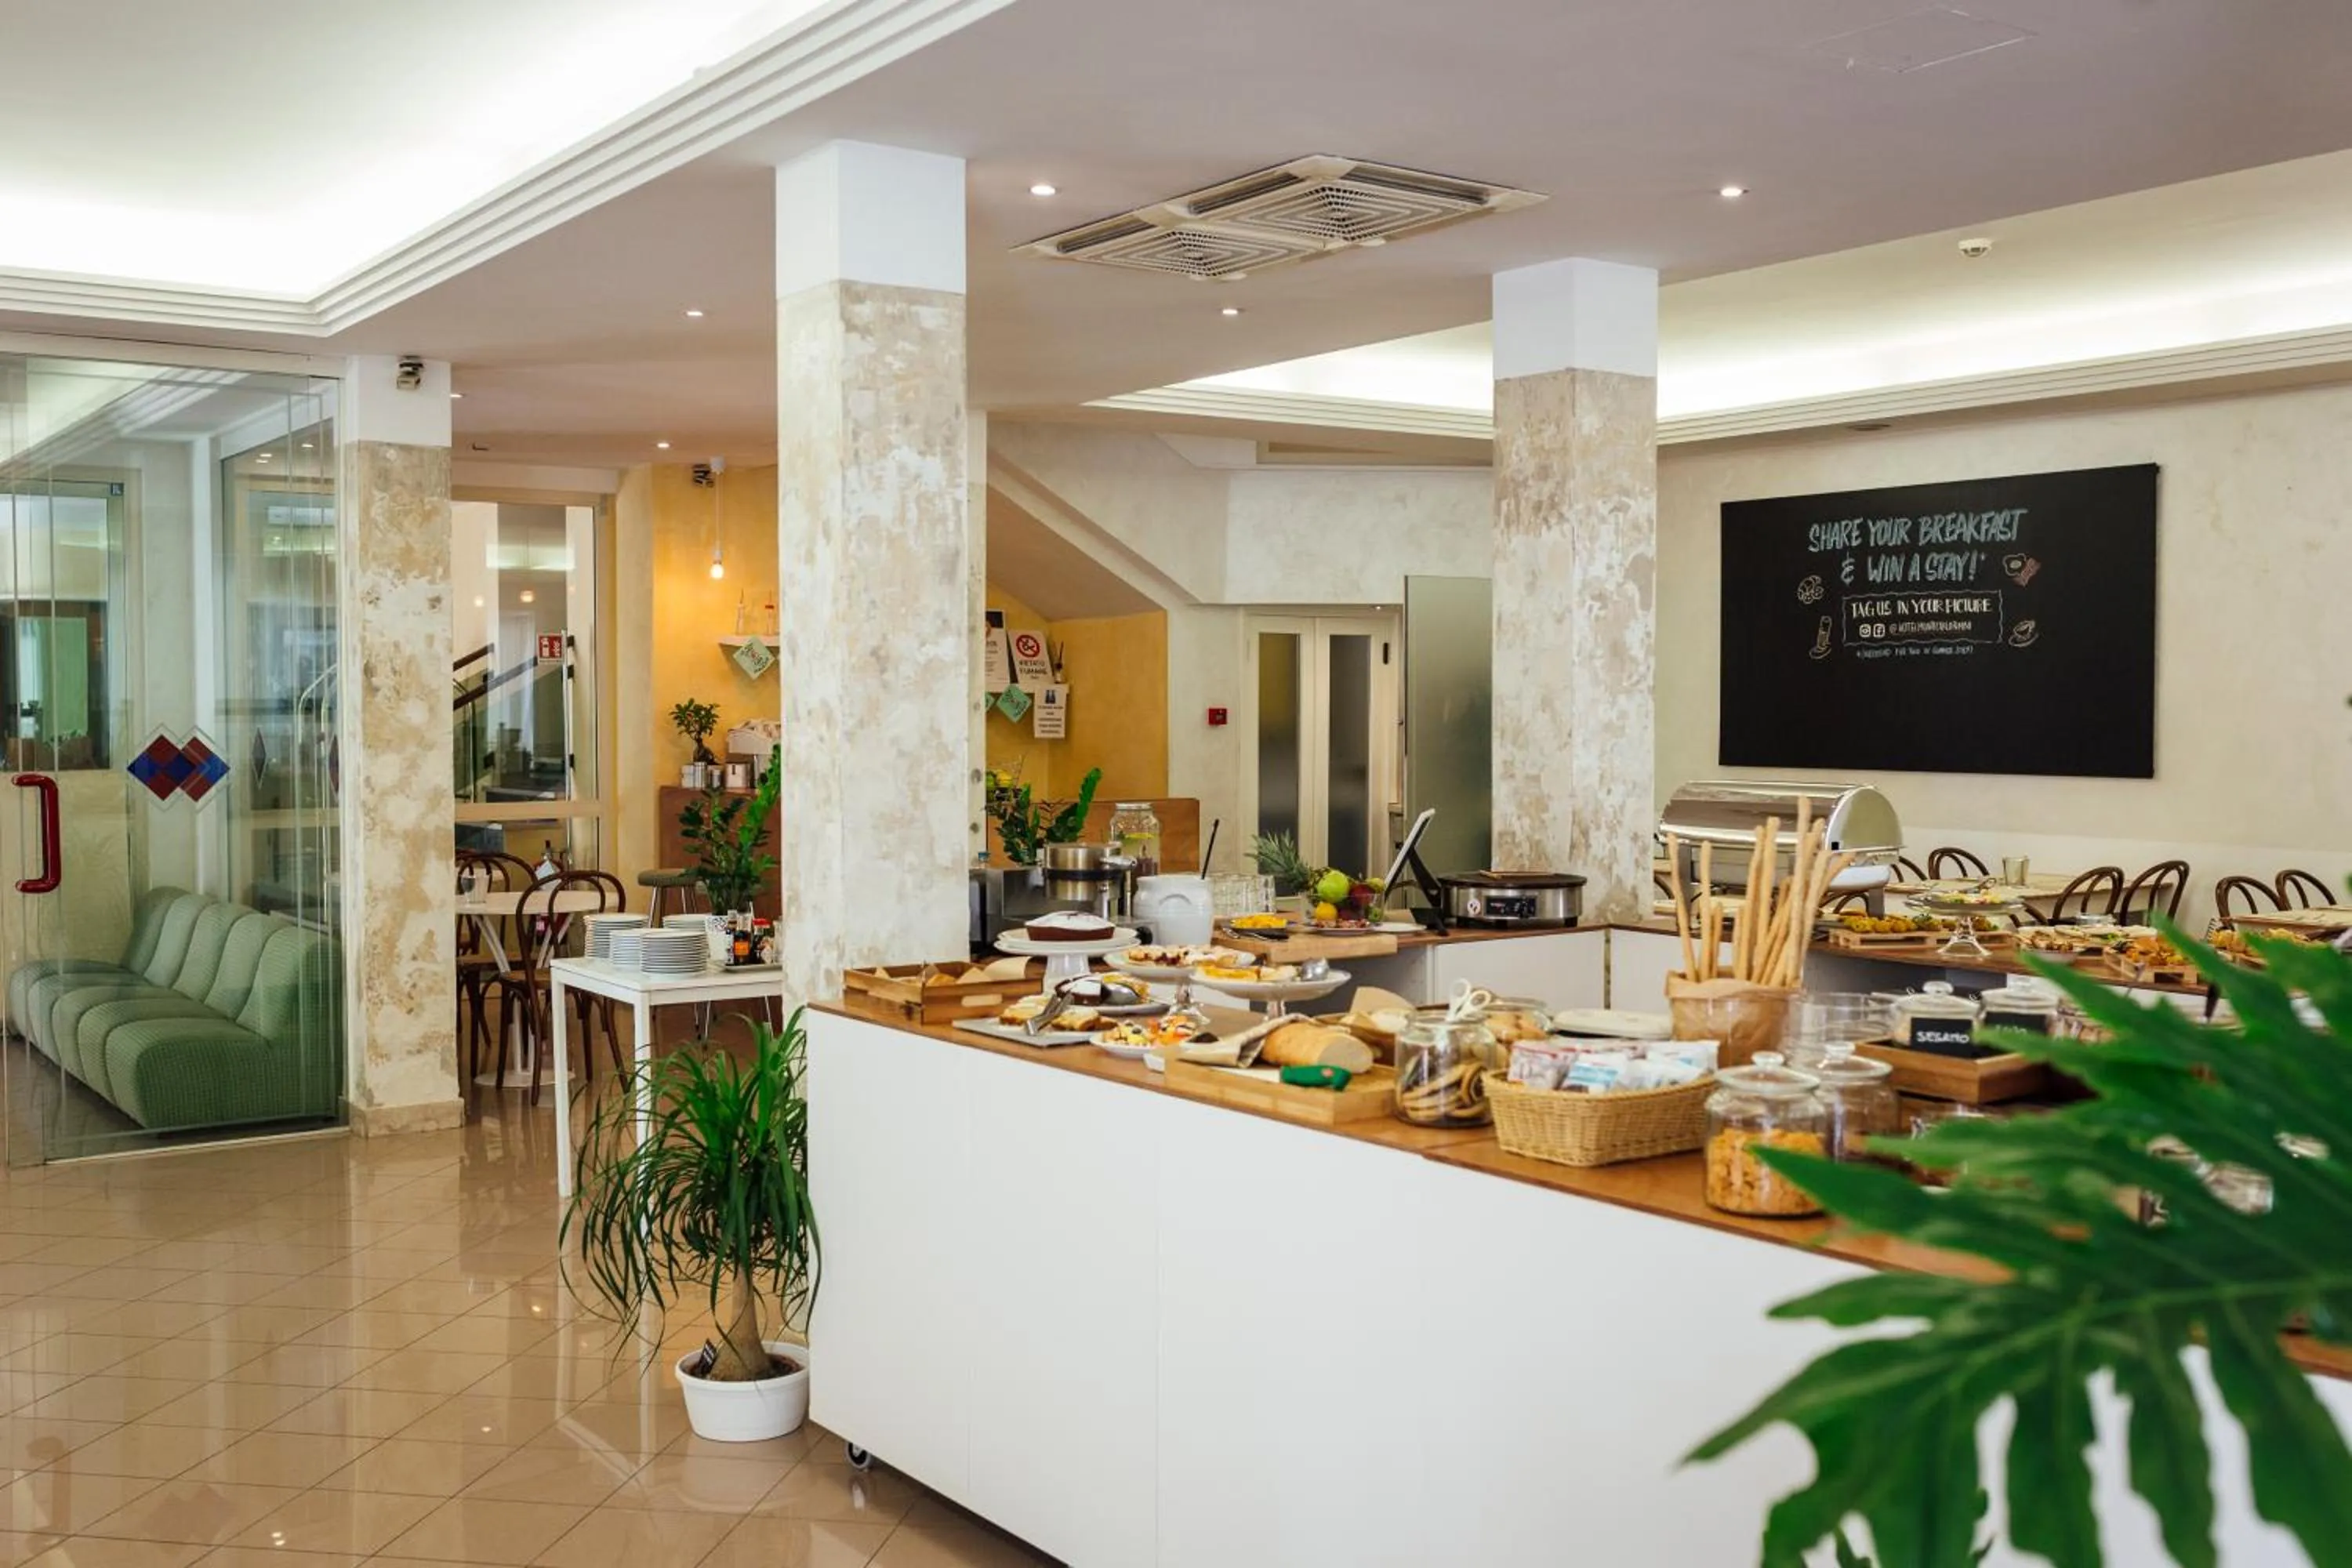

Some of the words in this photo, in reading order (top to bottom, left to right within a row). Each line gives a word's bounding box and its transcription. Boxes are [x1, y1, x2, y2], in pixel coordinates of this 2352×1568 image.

[1808, 517, 1864, 552] SHARE
[1868, 517, 1911, 546] YOUR
[1918, 509, 2028, 546] BREAKFAST
[1841, 551, 1855, 586] &
[1867, 553, 1905, 583] WIN
[1907, 554, 1921, 582] A
[1852, 601, 1875, 619] TAG
[1876, 600, 1892, 616] US
[1896, 599, 1910, 615] IN
[1911, 598, 1945, 615] YOUR
[1945, 597, 1993, 614] PICTURE
[1915, 1030, 1970, 1044] SESAMO
